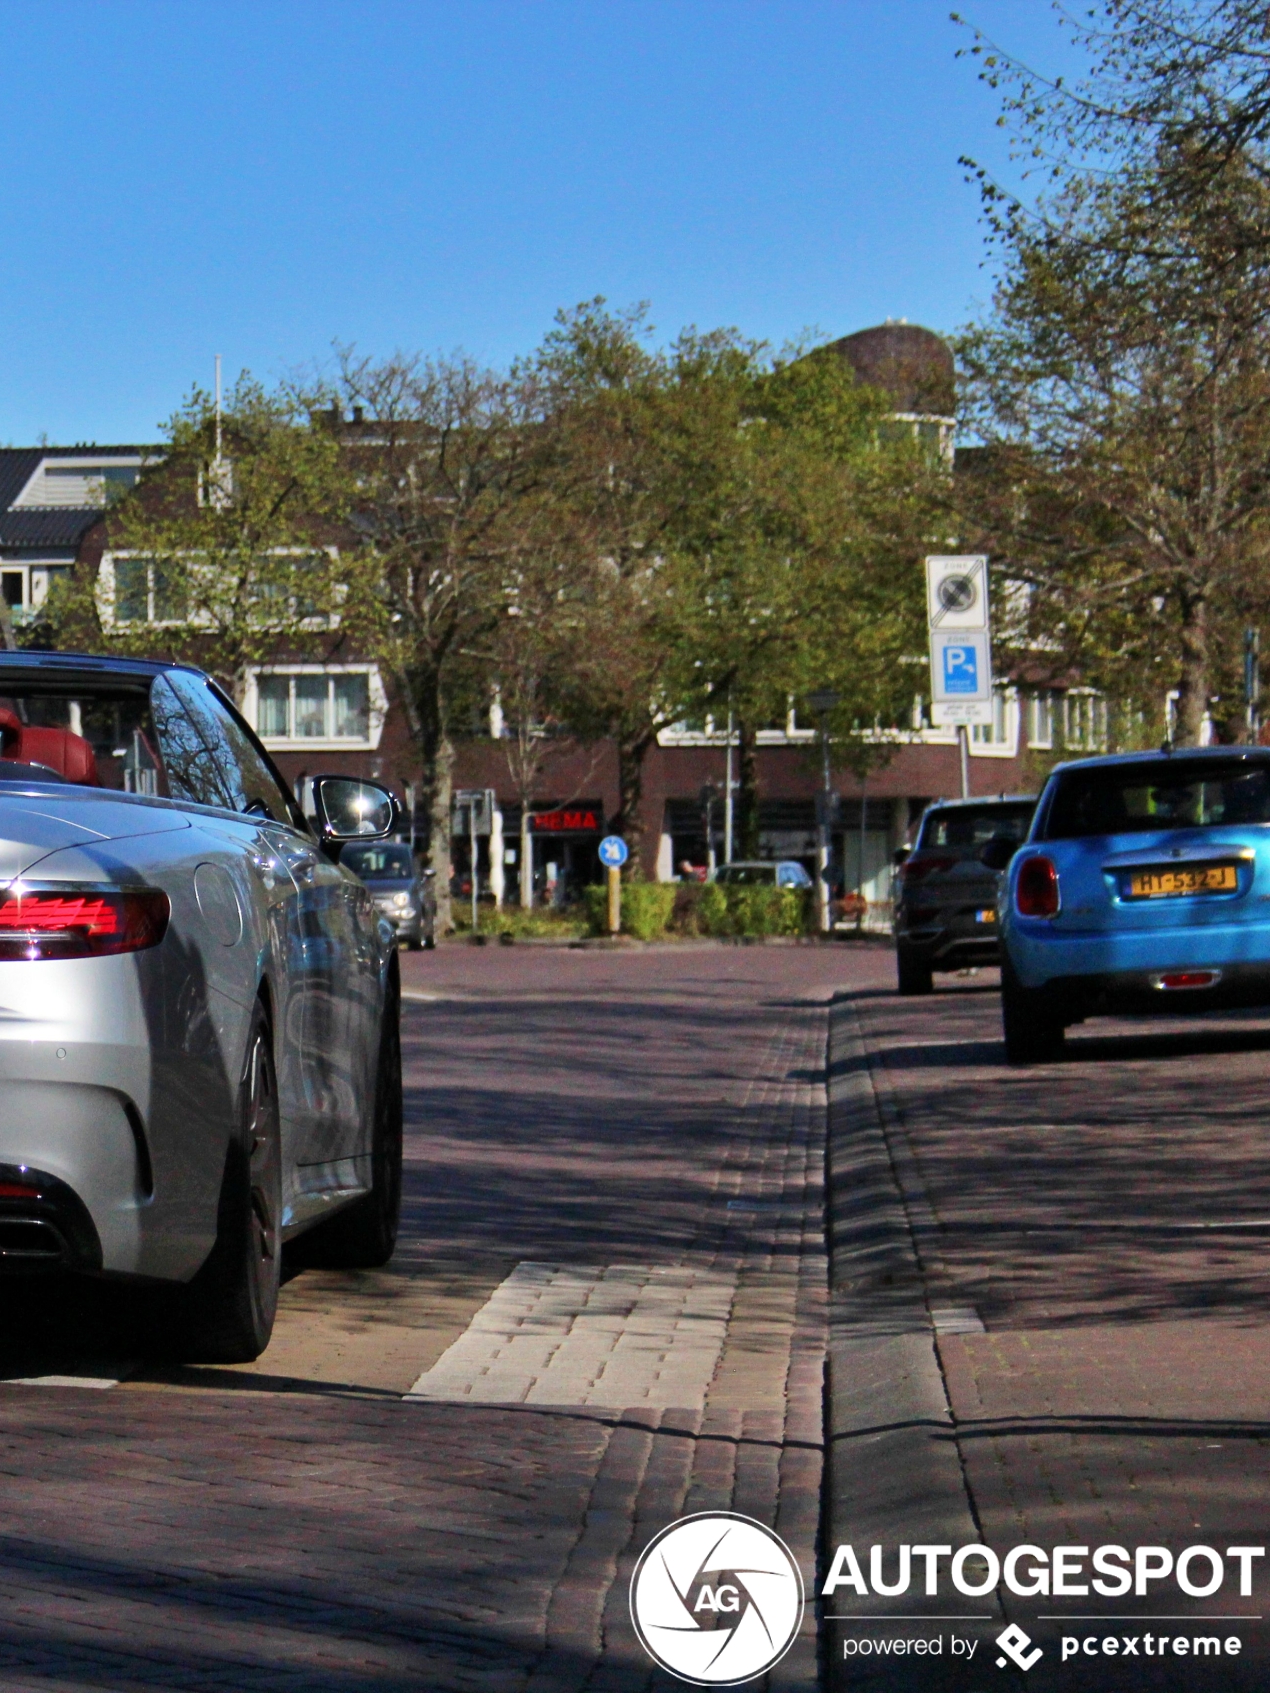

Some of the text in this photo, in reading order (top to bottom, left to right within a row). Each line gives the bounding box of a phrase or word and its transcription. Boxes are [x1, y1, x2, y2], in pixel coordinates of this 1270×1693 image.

[944, 562, 968, 570] ZONE
[947, 649, 965, 673] P
[534, 810, 597, 831] HEMA
